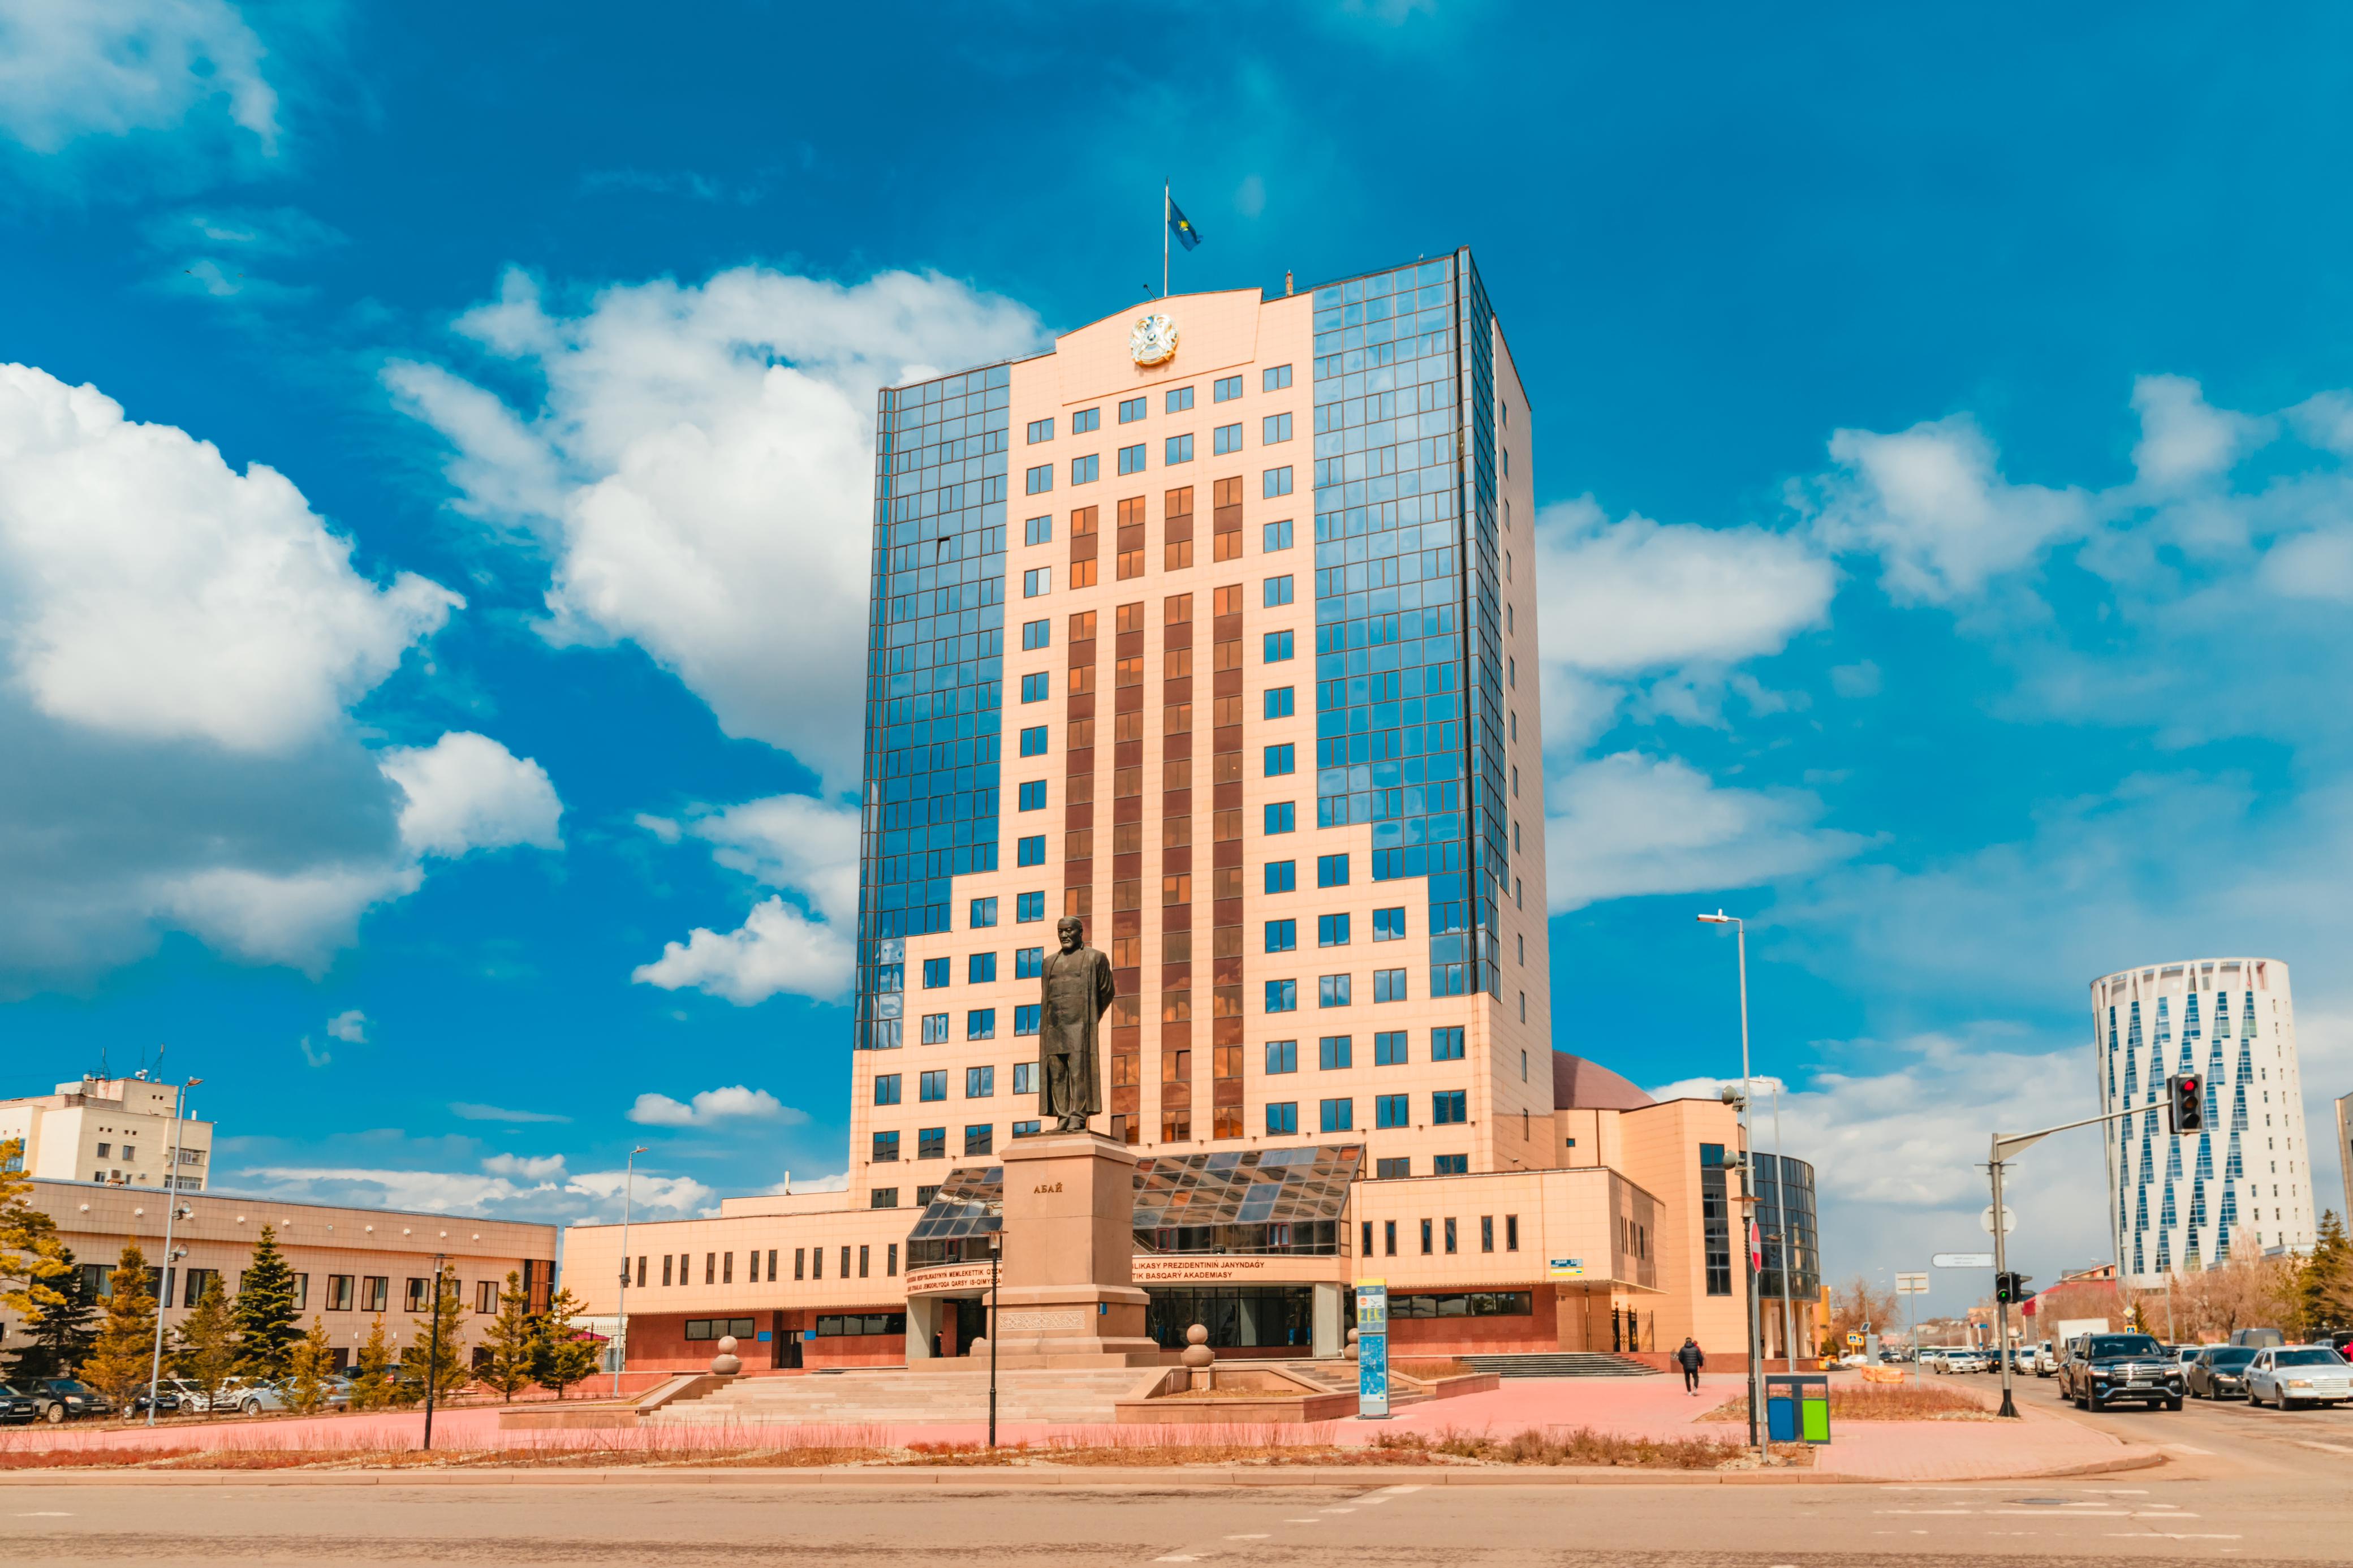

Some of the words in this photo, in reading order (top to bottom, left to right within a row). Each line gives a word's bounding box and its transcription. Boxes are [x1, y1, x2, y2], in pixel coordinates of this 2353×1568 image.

[1034, 1182, 1062, 1194] АБАЙ
[1163, 1260, 1218, 1269] PREZIDENTINIŃ
[949, 1269, 983, 1278] MEMLEKETTIK
[1146, 1270, 1182, 1279] BASQARÝ
